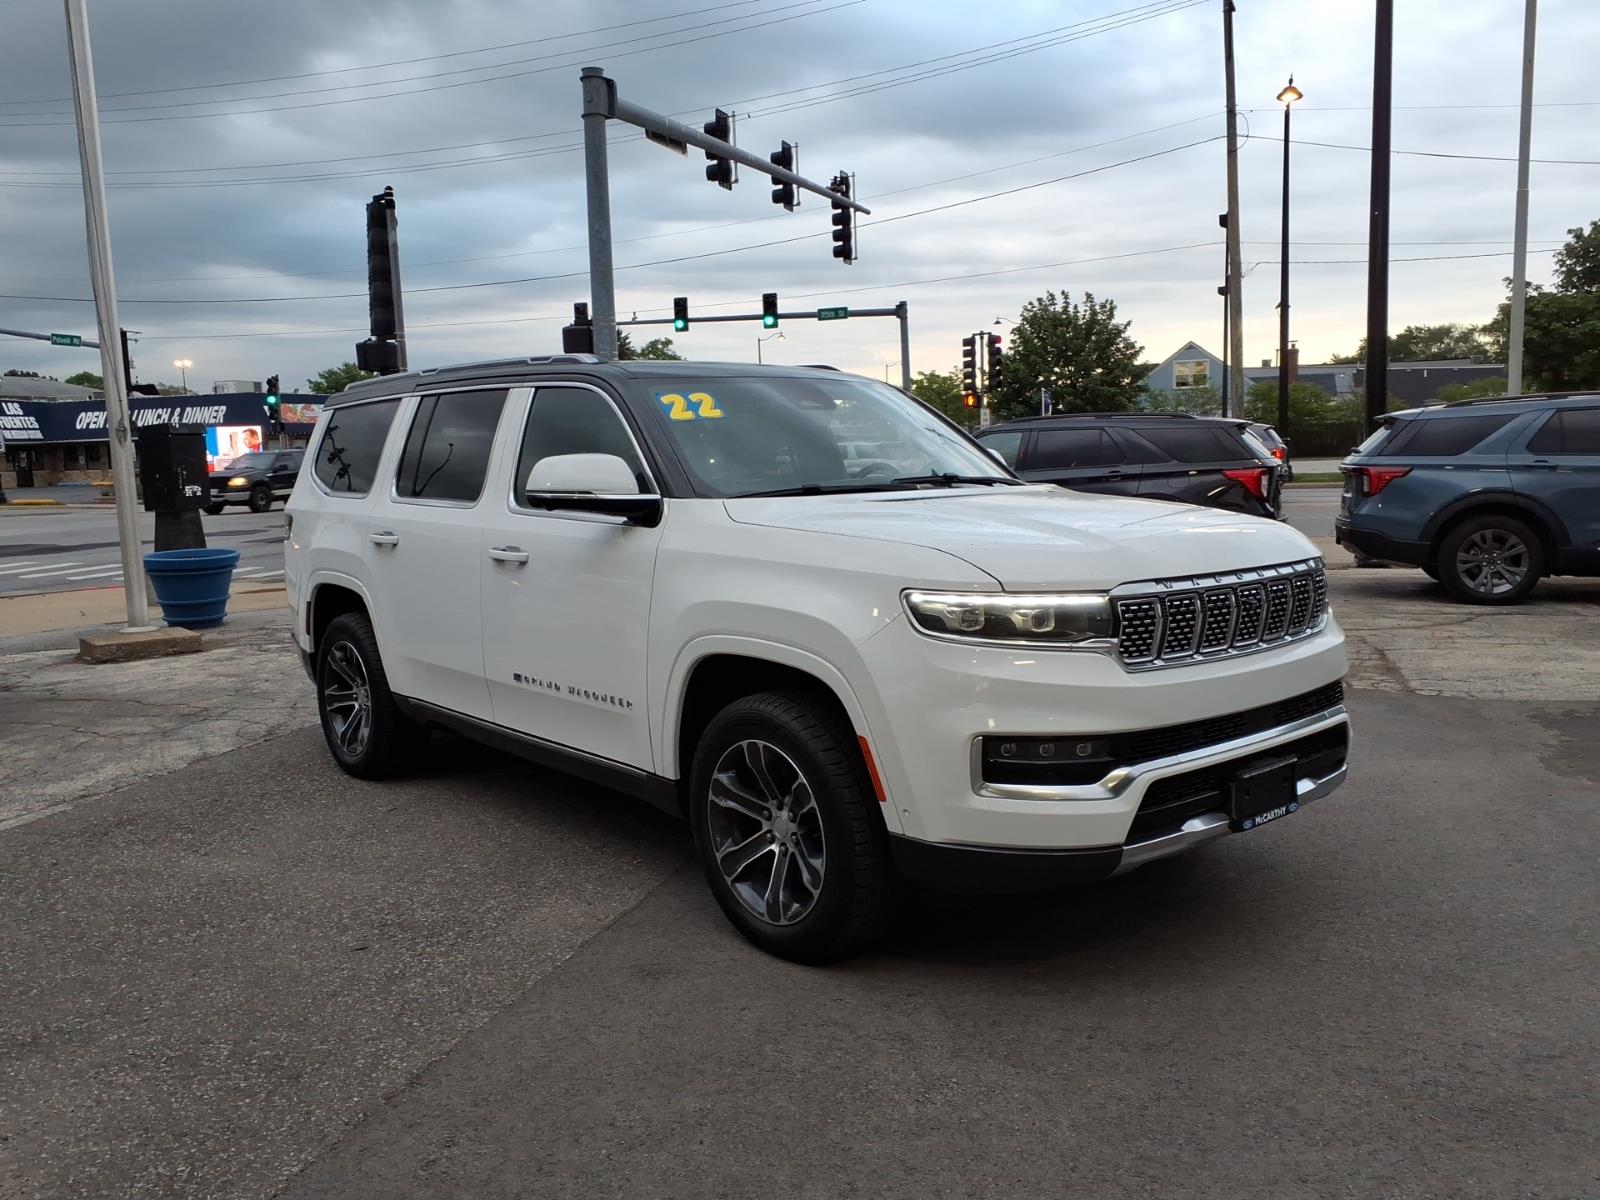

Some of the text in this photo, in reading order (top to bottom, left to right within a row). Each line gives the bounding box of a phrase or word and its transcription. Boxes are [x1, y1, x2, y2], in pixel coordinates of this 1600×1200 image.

[1, 402, 24, 416] LAS
[75, 411, 108, 430] OPEN
[182, 405, 227, 424] DINNER
[660, 392, 724, 421] 22
